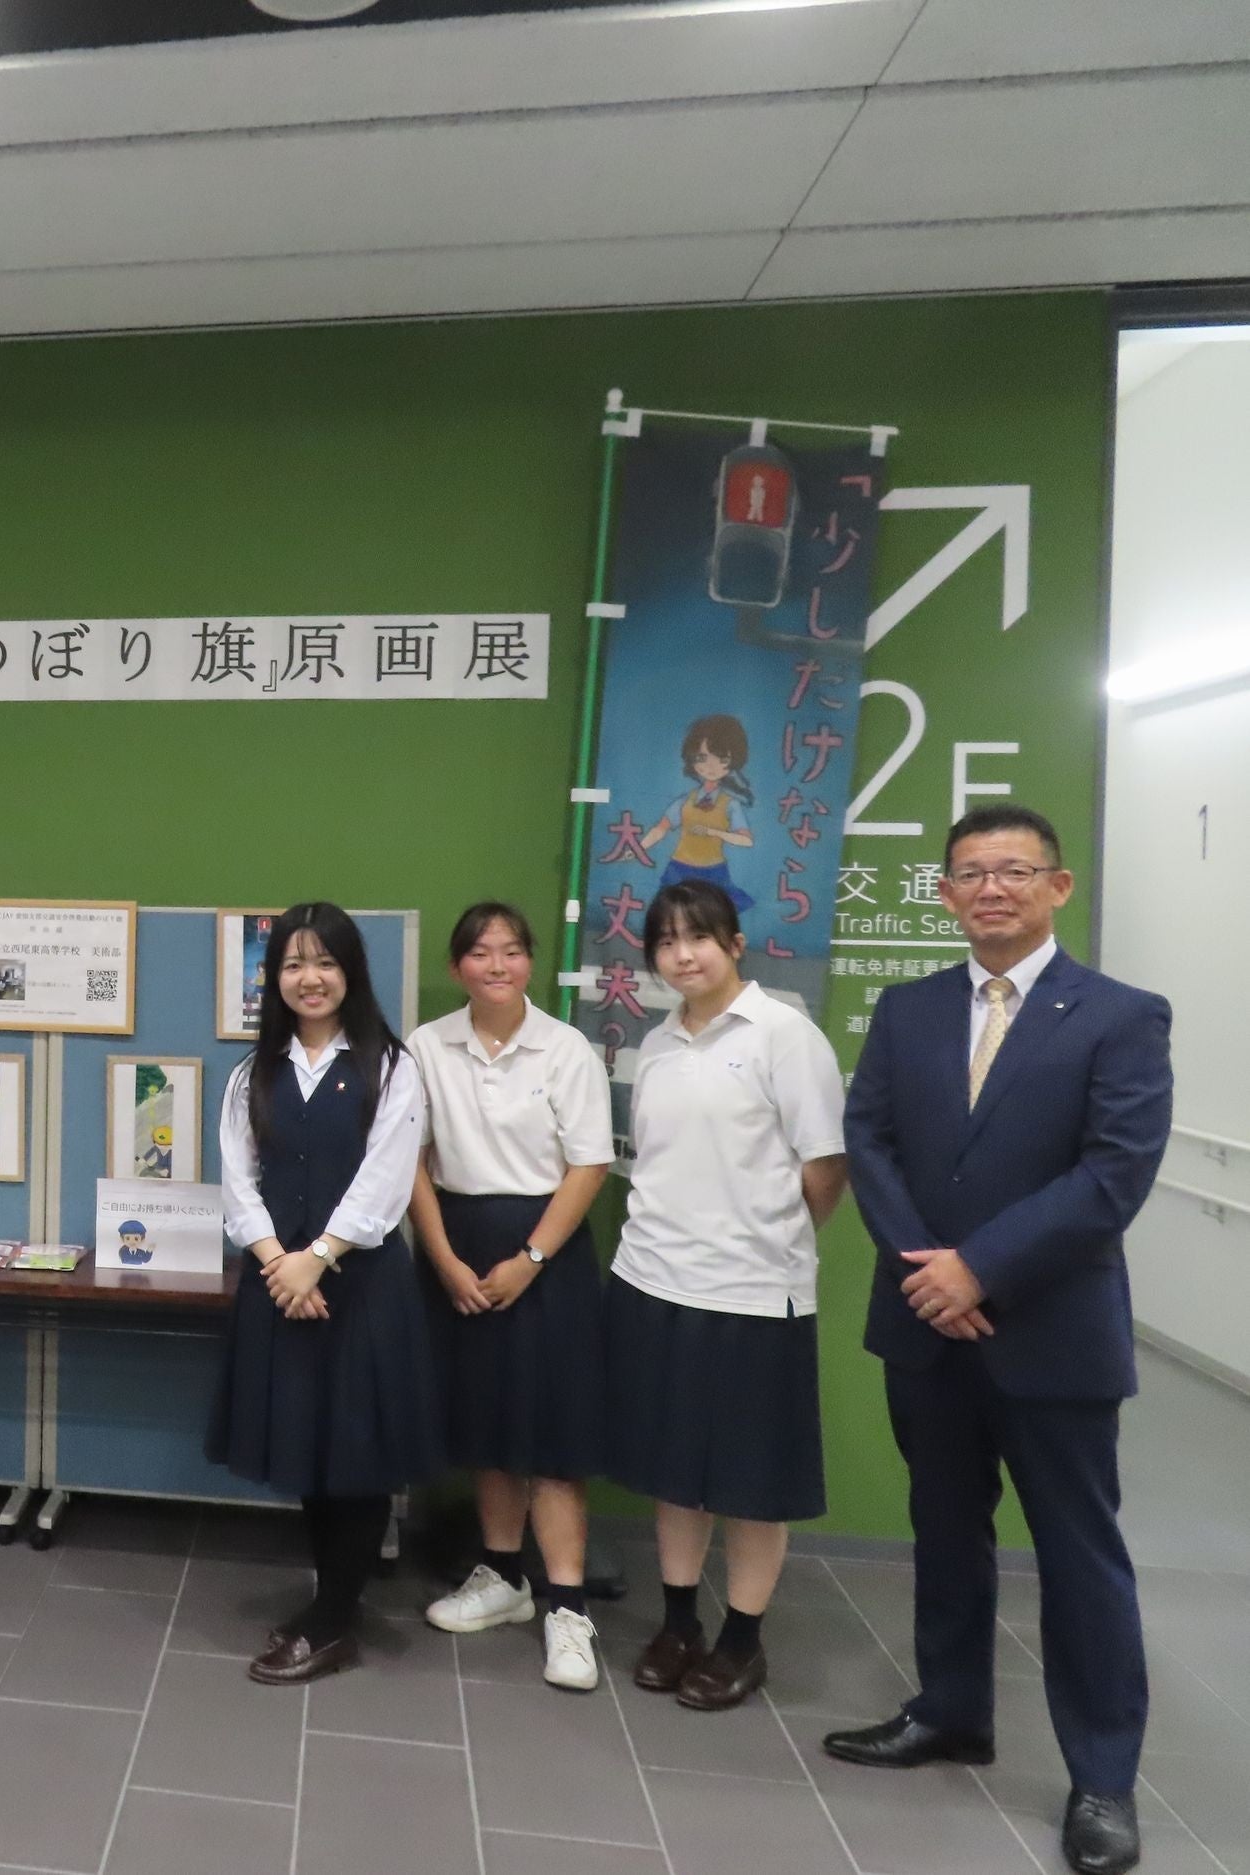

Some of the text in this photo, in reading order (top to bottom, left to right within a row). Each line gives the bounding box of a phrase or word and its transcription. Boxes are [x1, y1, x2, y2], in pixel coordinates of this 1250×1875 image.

[843, 680, 1020, 836] 2F
[836, 912, 912, 935] Traffic
[101, 1201, 215, 1217] ご自由にお持ち帰りください
